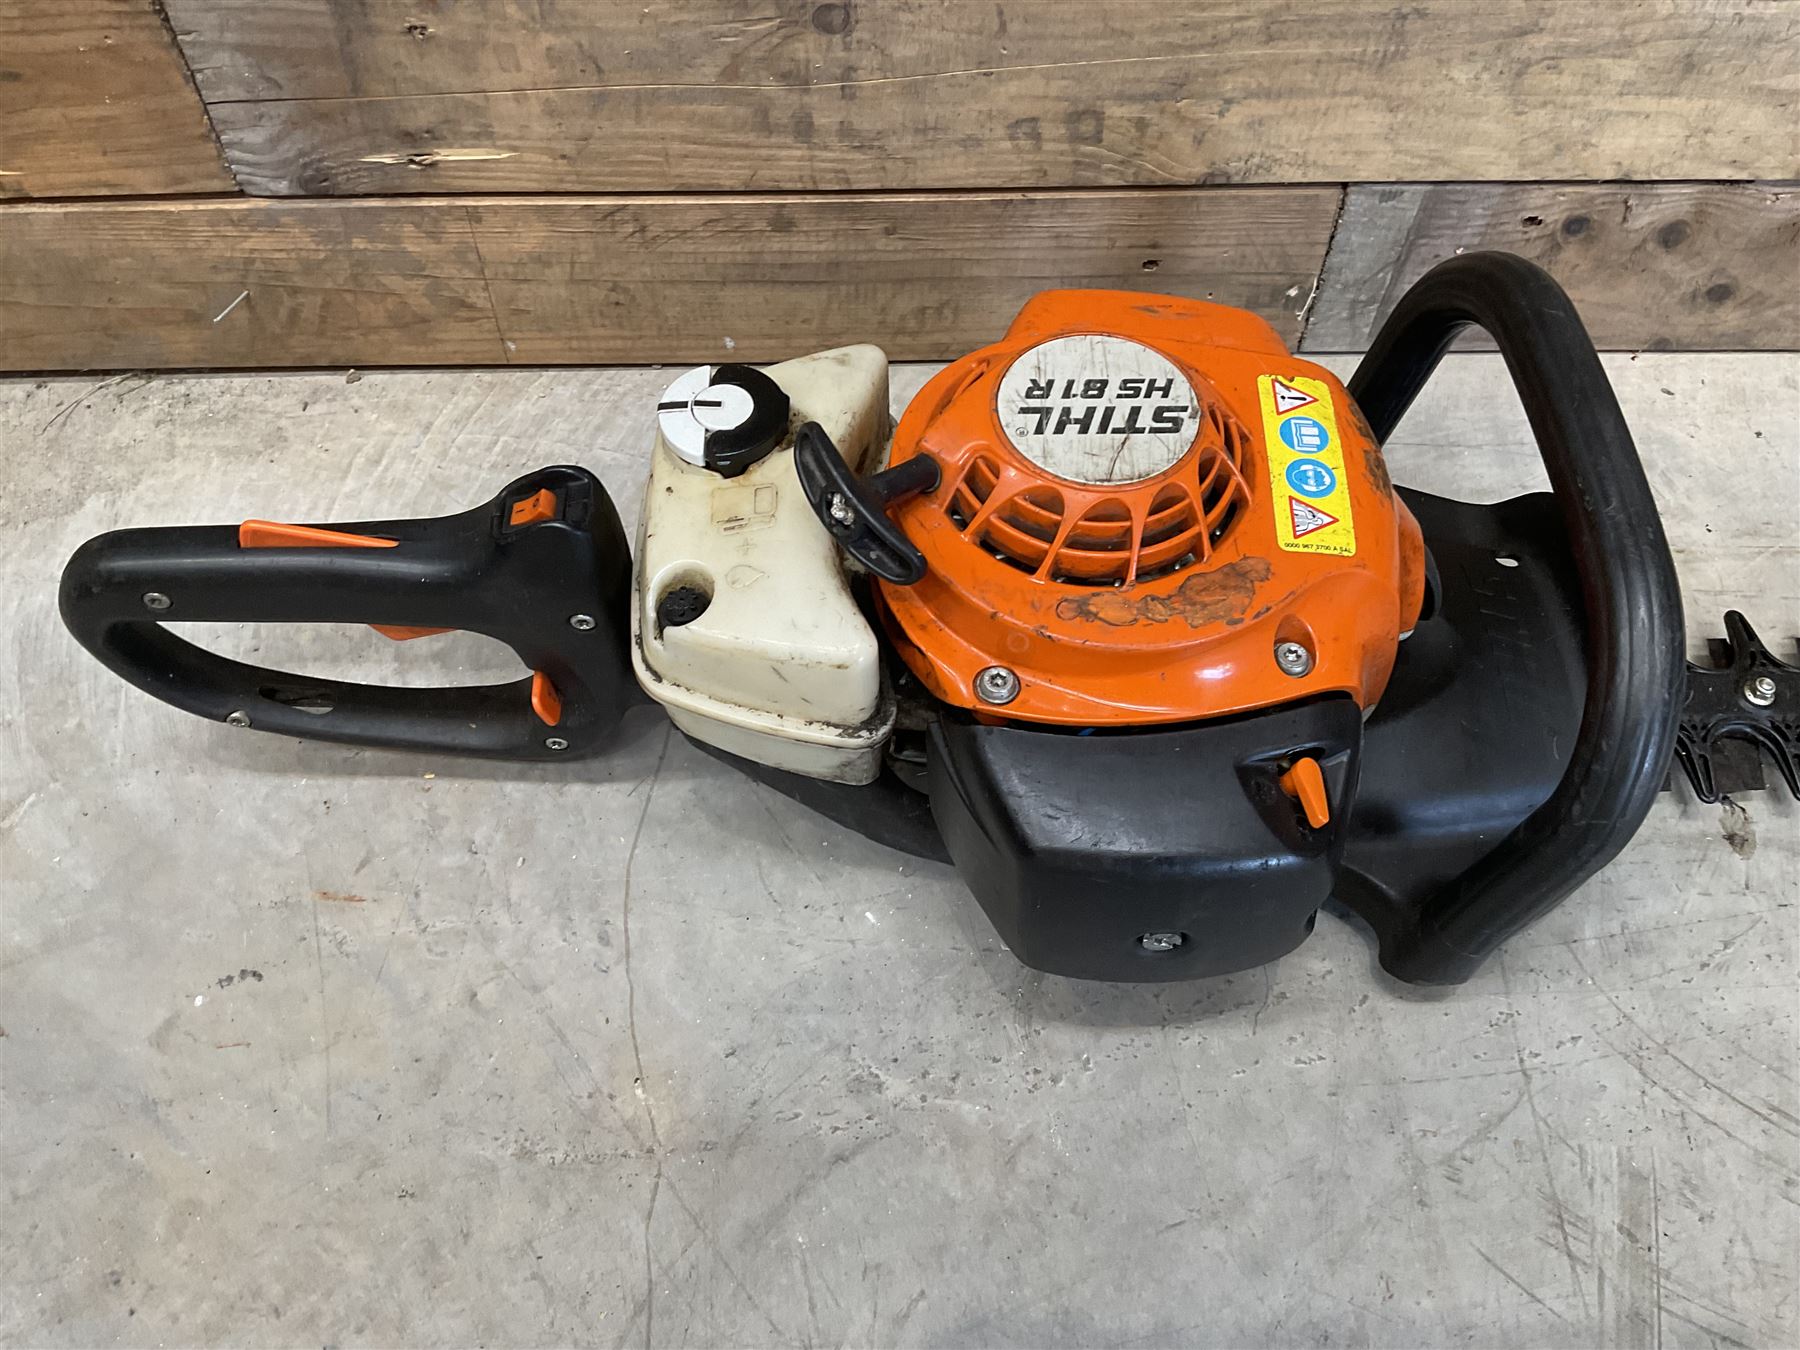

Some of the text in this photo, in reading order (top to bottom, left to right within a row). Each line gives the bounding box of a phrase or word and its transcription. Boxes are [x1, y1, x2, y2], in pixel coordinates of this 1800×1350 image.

[1025, 378, 1174, 399] HS 81 R
[1017, 405, 1189, 435] STIHL
